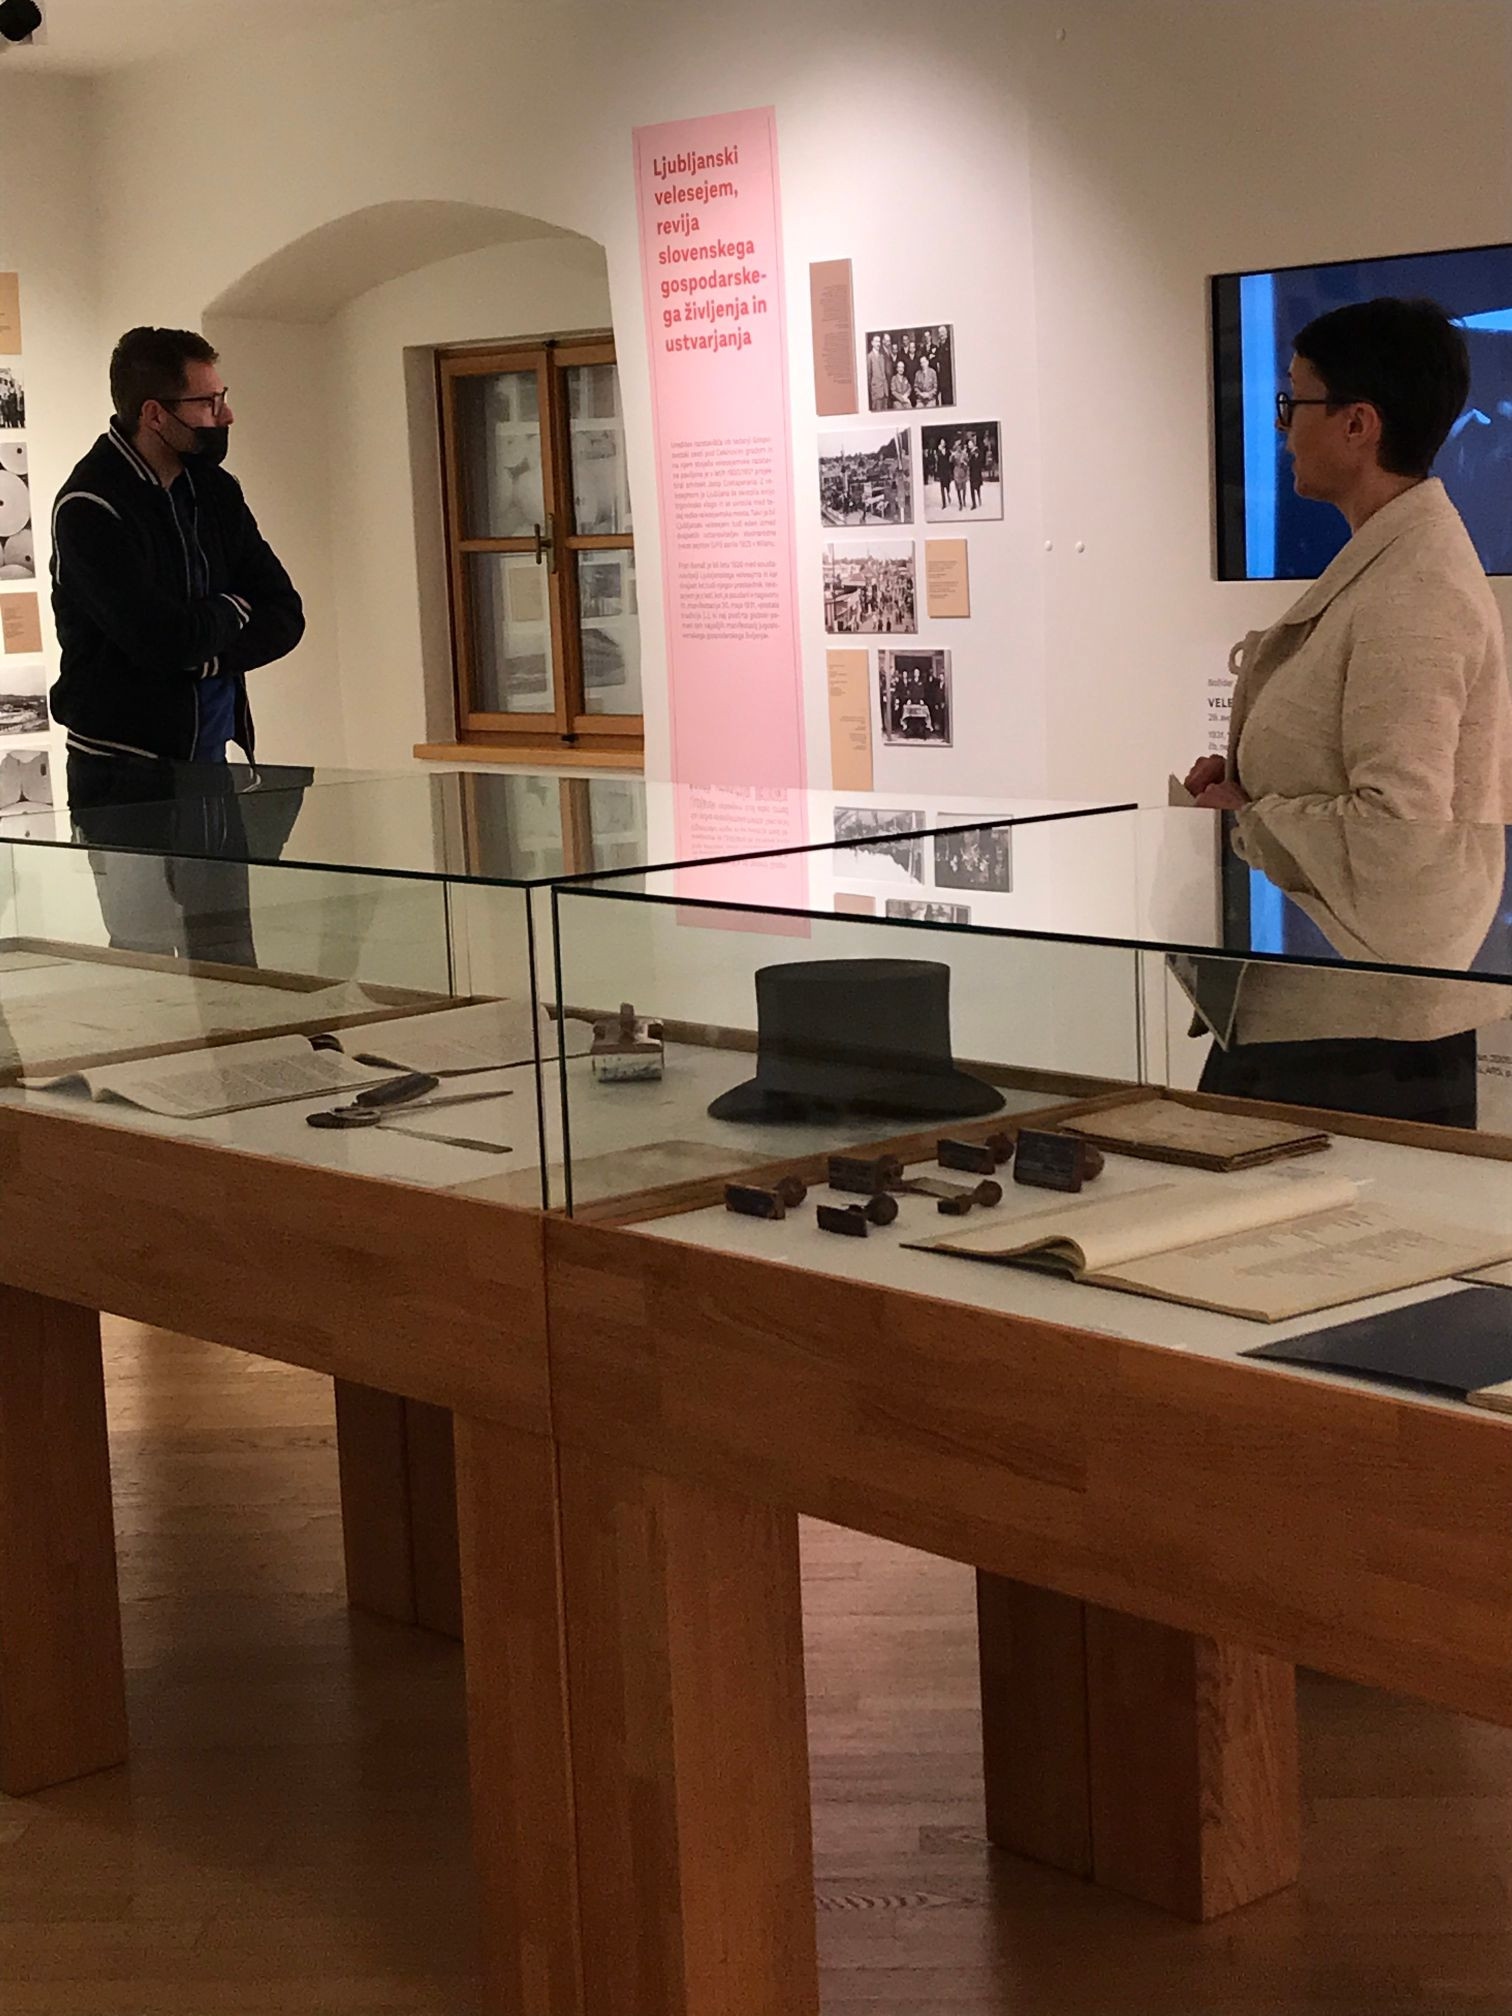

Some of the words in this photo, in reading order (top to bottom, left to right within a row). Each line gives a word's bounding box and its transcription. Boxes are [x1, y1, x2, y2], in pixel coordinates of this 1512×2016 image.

[653, 144, 739, 180] Ljubljanski
[654, 180, 738, 206] velesejem,
[657, 212, 700, 237] revija
[658, 239, 755, 265] slovenskega
[660, 265, 767, 299] gospodarske-
[663, 308, 682, 328] ga
[684, 297, 750, 324] življenja
[752, 294, 768, 315] in
[665, 326, 752, 353] ustvarjanja
